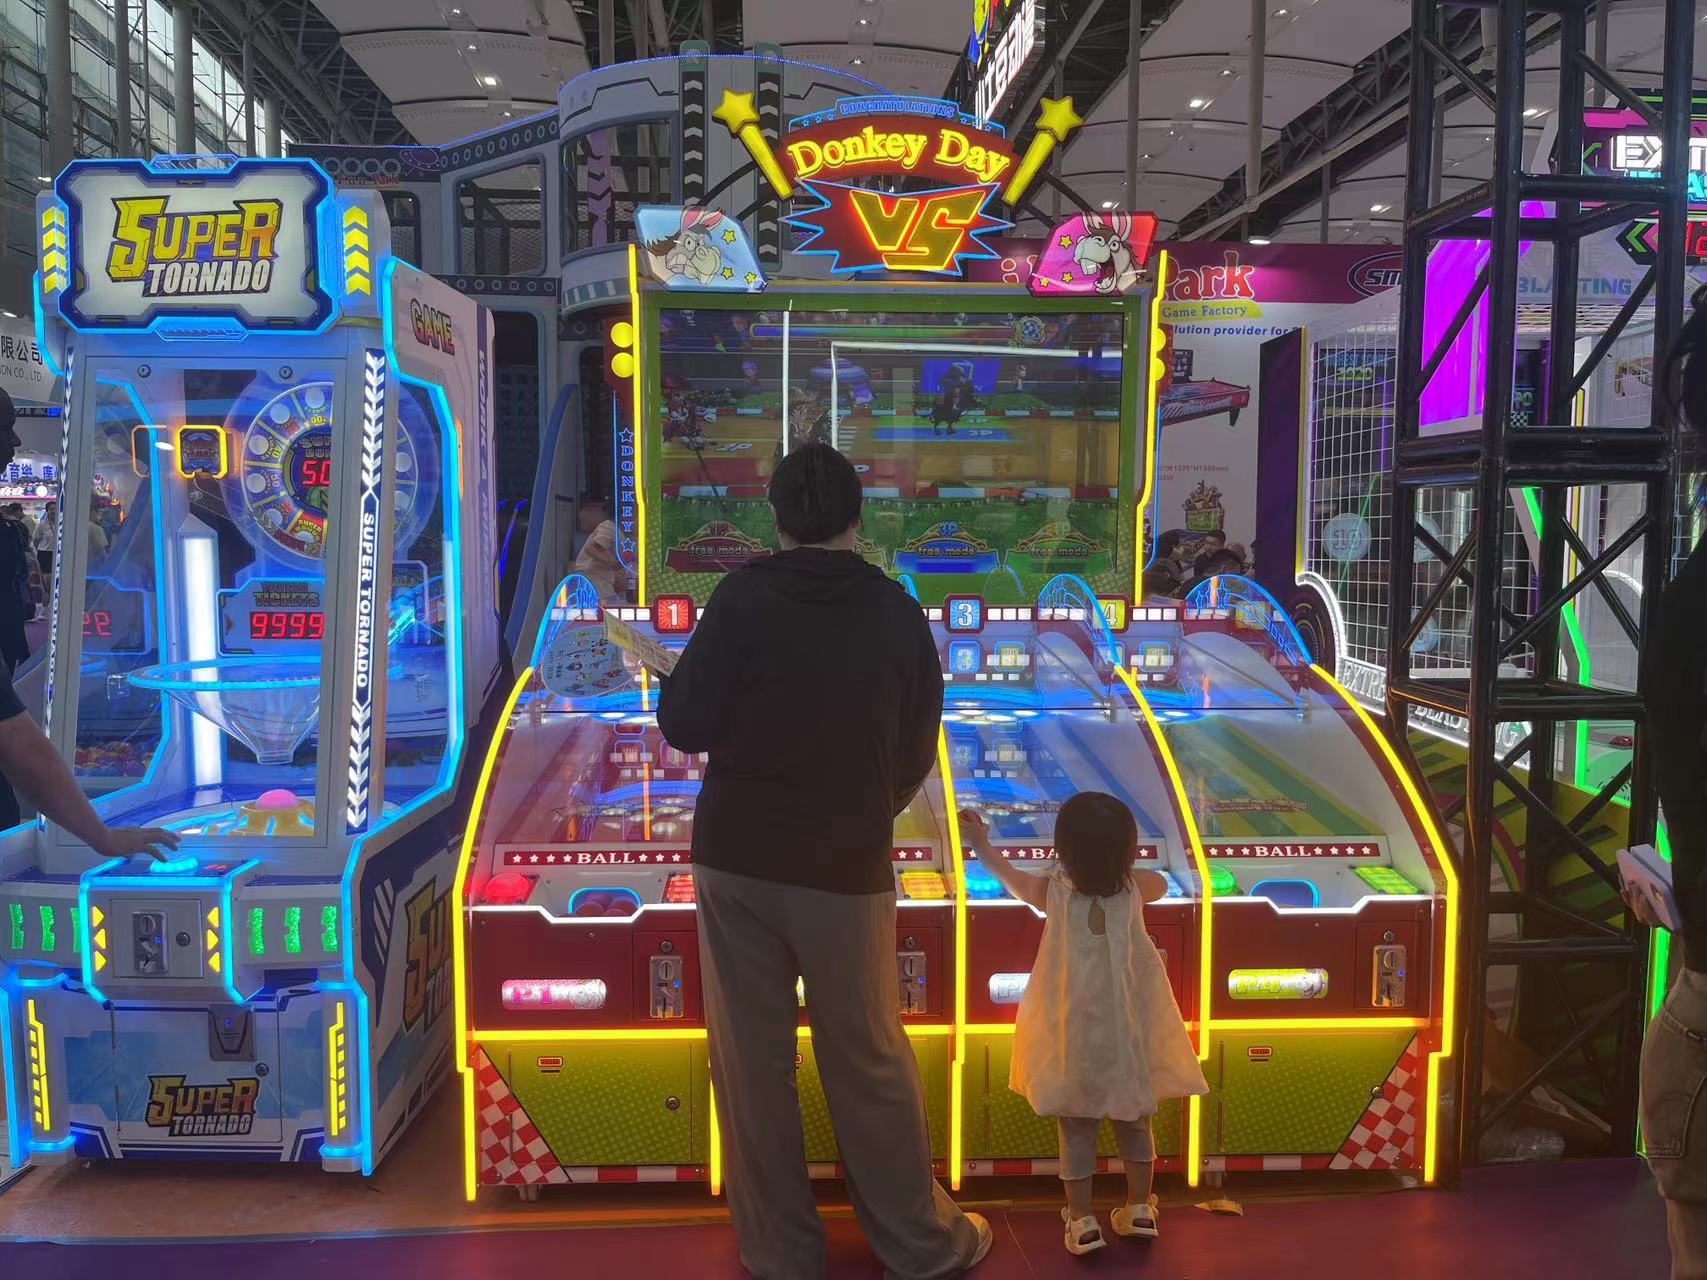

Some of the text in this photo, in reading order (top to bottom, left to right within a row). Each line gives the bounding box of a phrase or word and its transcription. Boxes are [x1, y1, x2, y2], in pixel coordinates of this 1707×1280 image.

[839, 101, 955, 118] CONGRATULATIONS
[787, 126, 1011, 184] Donkey Day
[105, 197, 281, 283] SUPER
[848, 188, 987, 270] VS
[148, 259, 271, 296] TORNADO
[1162, 305, 1248, 319] Game Factory
[410, 298, 456, 355] GAME
[1174, 325, 1210, 334] lution
[1214, 325, 1267, 337] provider
[1270, 326, 1288, 337] for
[478, 349, 488, 448] WORK
[621, 445, 636, 532] DONKEY
[298, 518, 323, 533] SUPER
[688, 545, 750, 557] free mode
[917, 546, 976, 558] free mode
[1031, 546, 1089, 558] free mode
[254, 592, 321, 607] TICKETS
[356, 513, 375, 687] SUPER TORNADO
[666, 602, 679, 626] 1
[957, 603, 973, 626] 3
[1103, 602, 1117, 627] 4
[252, 613, 326, 639] 9999
[577, 852, 635, 864] BALL
[1255, 845, 1311, 857] BALL
[511, 985, 552, 1005] P1
[1236, 974, 1283, 995] P4
[145, 1074, 260, 1128] SUPER
[170, 1113, 252, 1137] TORNADO
